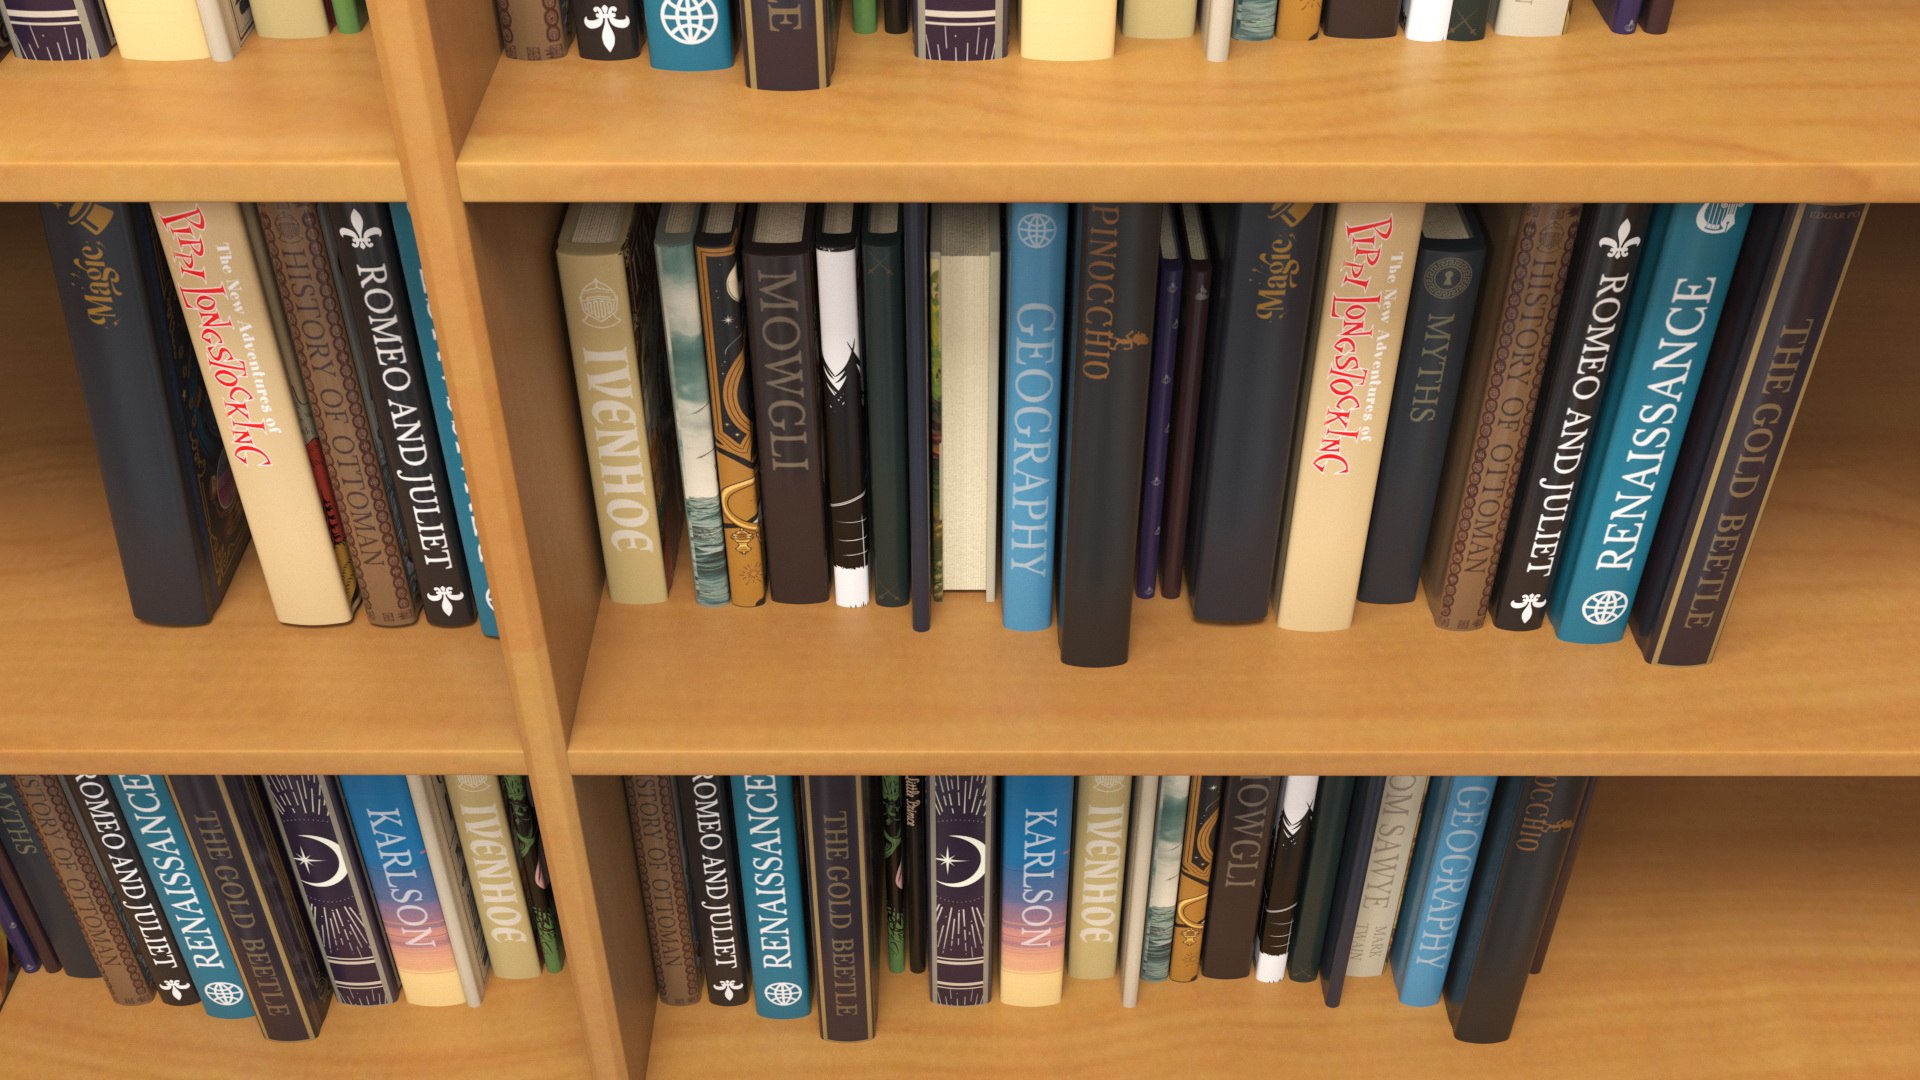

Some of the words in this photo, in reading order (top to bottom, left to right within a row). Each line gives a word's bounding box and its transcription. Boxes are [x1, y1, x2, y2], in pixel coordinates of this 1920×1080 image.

[84, 242, 122, 326] Magic
[281, 248, 336, 376] HISTORY
[1082, 205, 1120, 380] PINOCCHIO
[1255, 239, 1300, 320] Magic
[1379, 288, 1399, 325] New
[1386, 251, 1405, 288] The
[215, 242, 233, 277] The
[224, 276, 248, 320] New
[236, 318, 274, 414] Adventures
[264, 416, 282, 434] of
[356, 263, 411, 392] ROMEO
[757, 268, 809, 471] MOWGLI
[1409, 312, 1456, 424] MYTHS
[1508, 260, 1553, 386] HISTORY
[1571, 272, 1630, 400] ROMEO
[1761, 317, 1815, 394] THE
[320, 388, 349, 424] OF
[1362, 329, 1391, 421] Adventures
[1500, 396, 1525, 433] OF
[1595, 276, 1719, 572] RENAISSANCE
[388, 398, 430, 467] AND
[582, 346, 654, 553] IVENHOE
[1009, 302, 1057, 578] GEOGRAPHY
[1359, 424, 1373, 442] of
[1554, 407, 1592, 475] AND
[1728, 402, 1783, 499] GOLD
[333, 435, 385, 567] OTTOMAN
[397, 467, 453, 570] JULIET
[1463, 442, 1513, 575] OTTOMAN
[1525, 476, 1575, 577] JULIET
[1683, 512, 1748, 630] BEETLE
[636, 777, 663, 841] STORY
[823, 810, 848, 861] THE
[1225, 776, 1271, 887] OWGLI
[1516, 776, 1557, 851] OCCHIO
[19, 777, 65, 841] STORY
[53, 846, 74, 873] OF
[67, 878, 123, 968] OTTOMAN
[108, 854, 147, 900] AND
[118, 775, 226, 970] RENAISSANCE
[366, 807, 437, 949] KARLSON
[460, 803, 528, 944] IVENHOE
[647, 847, 669, 872] OF
[702, 854, 729, 900] AND
[744, 775, 793, 970] RENAISSANCE
[826, 866, 852, 930] GOLD
[1020, 808, 1058, 948] KARLSON
[1079, 803, 1126, 944] IVENHOE
[1362, 823, 1405, 909] SAWYE
[1415, 785, 1490, 969] GEOGRAPHY
[122, 900, 178, 970] JULIET
[194, 810, 231, 861] THE
[214, 865, 256, 930] GOLD
[241, 937, 291, 1017] BEETLE
[652, 877, 682, 968] OTTOMAN
[701, 900, 738, 969] JULIET
[1350, 923, 1369, 961] TWAIN
[1368, 925, 1388, 958] MARK
[831, 938, 858, 1017] BEETLE
